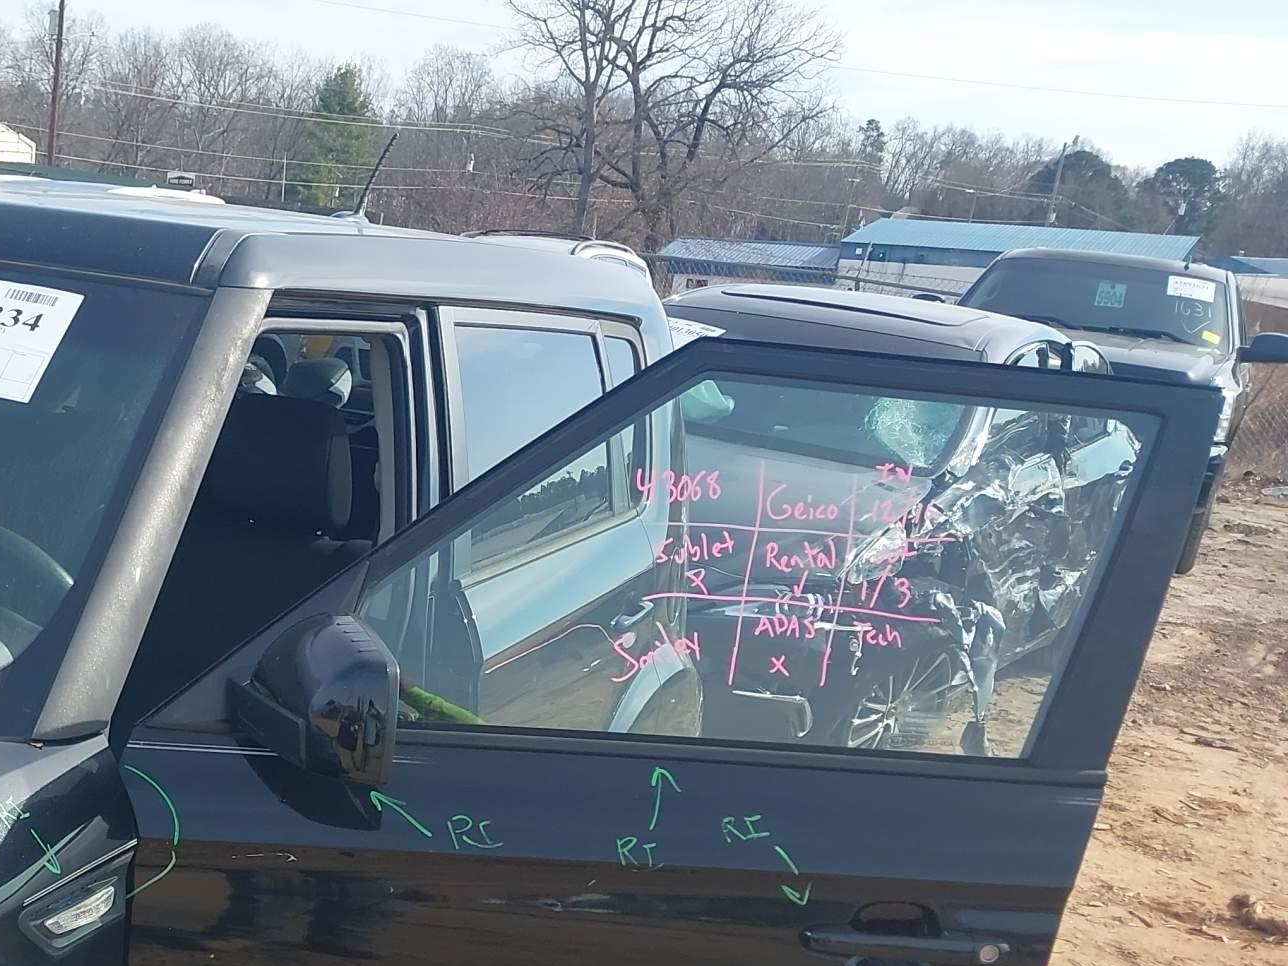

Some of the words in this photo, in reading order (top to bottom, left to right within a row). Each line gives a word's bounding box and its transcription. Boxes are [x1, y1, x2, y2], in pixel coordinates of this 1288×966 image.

[636, 468, 722, 504] 43068
[766, 484, 839, 521] Geico
[766, 536, 837, 573] Rental
[856, 622, 903, 648] Tech
